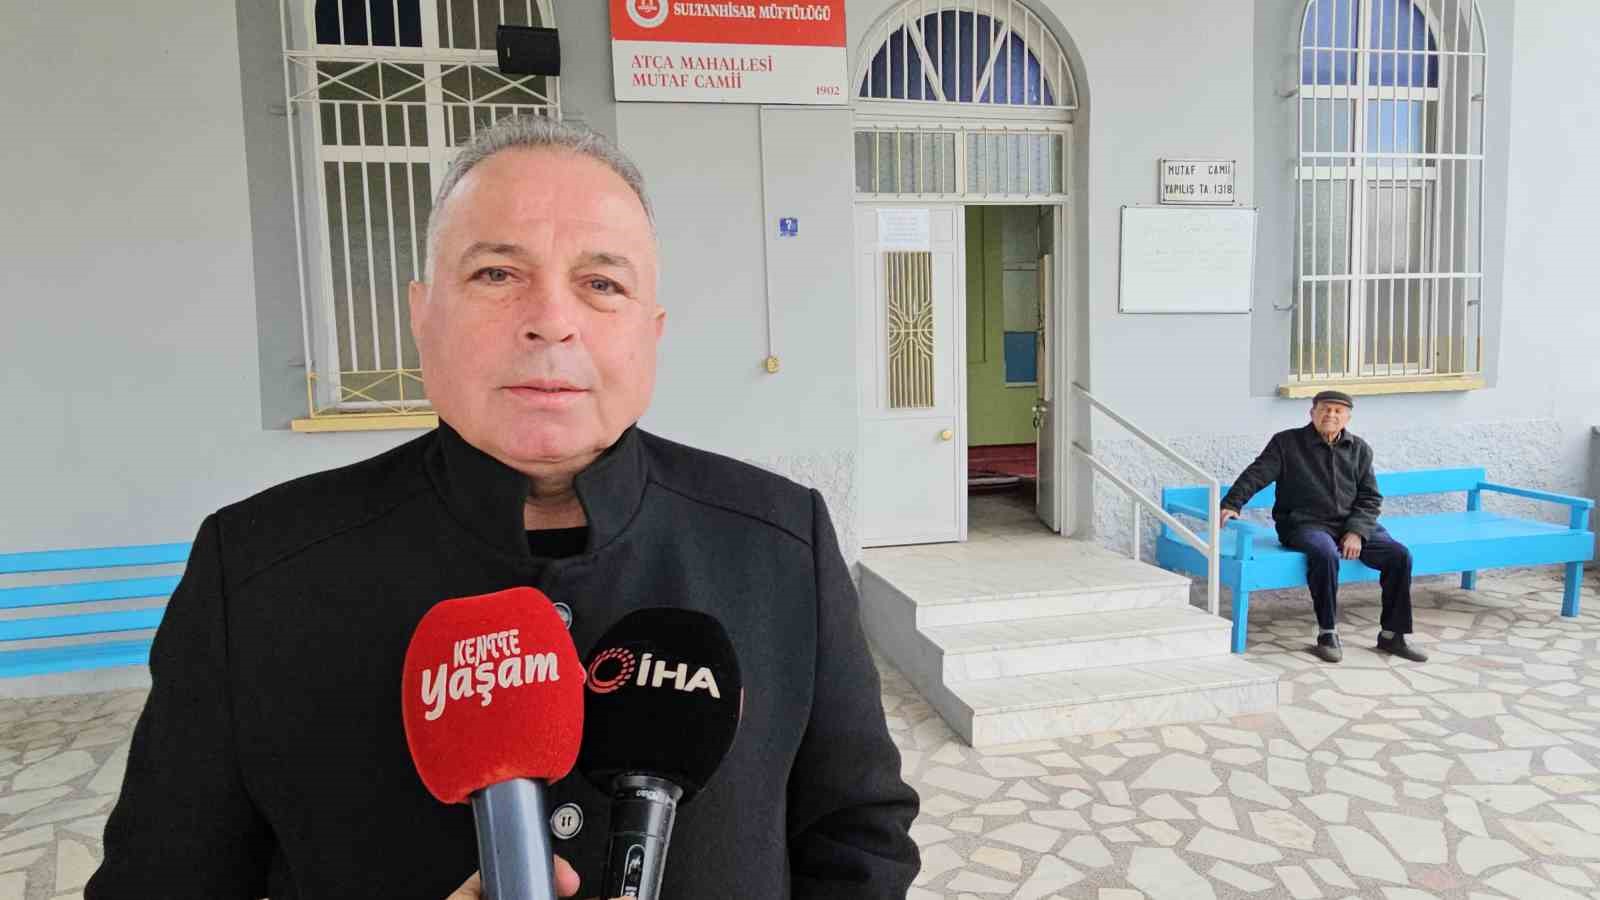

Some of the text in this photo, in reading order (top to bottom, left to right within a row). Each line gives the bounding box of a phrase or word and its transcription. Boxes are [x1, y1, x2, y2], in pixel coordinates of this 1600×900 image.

[673, 2, 756, 18] SULTANHİSAR
[759, 4, 831, 21] MÜFTÜLÜĞÜ
[631, 55, 775, 73] ATÇA MAHALLESİ
[632, 72, 742, 89] MUTAF CAMİİ
[815, 86, 841, 96] 1902
[1168, 165, 1195, 176] MUTAF
[453, 628, 521, 668] KENTTE
[635, 653, 721, 699] İHA
[421, 652, 560, 721] yaşam
